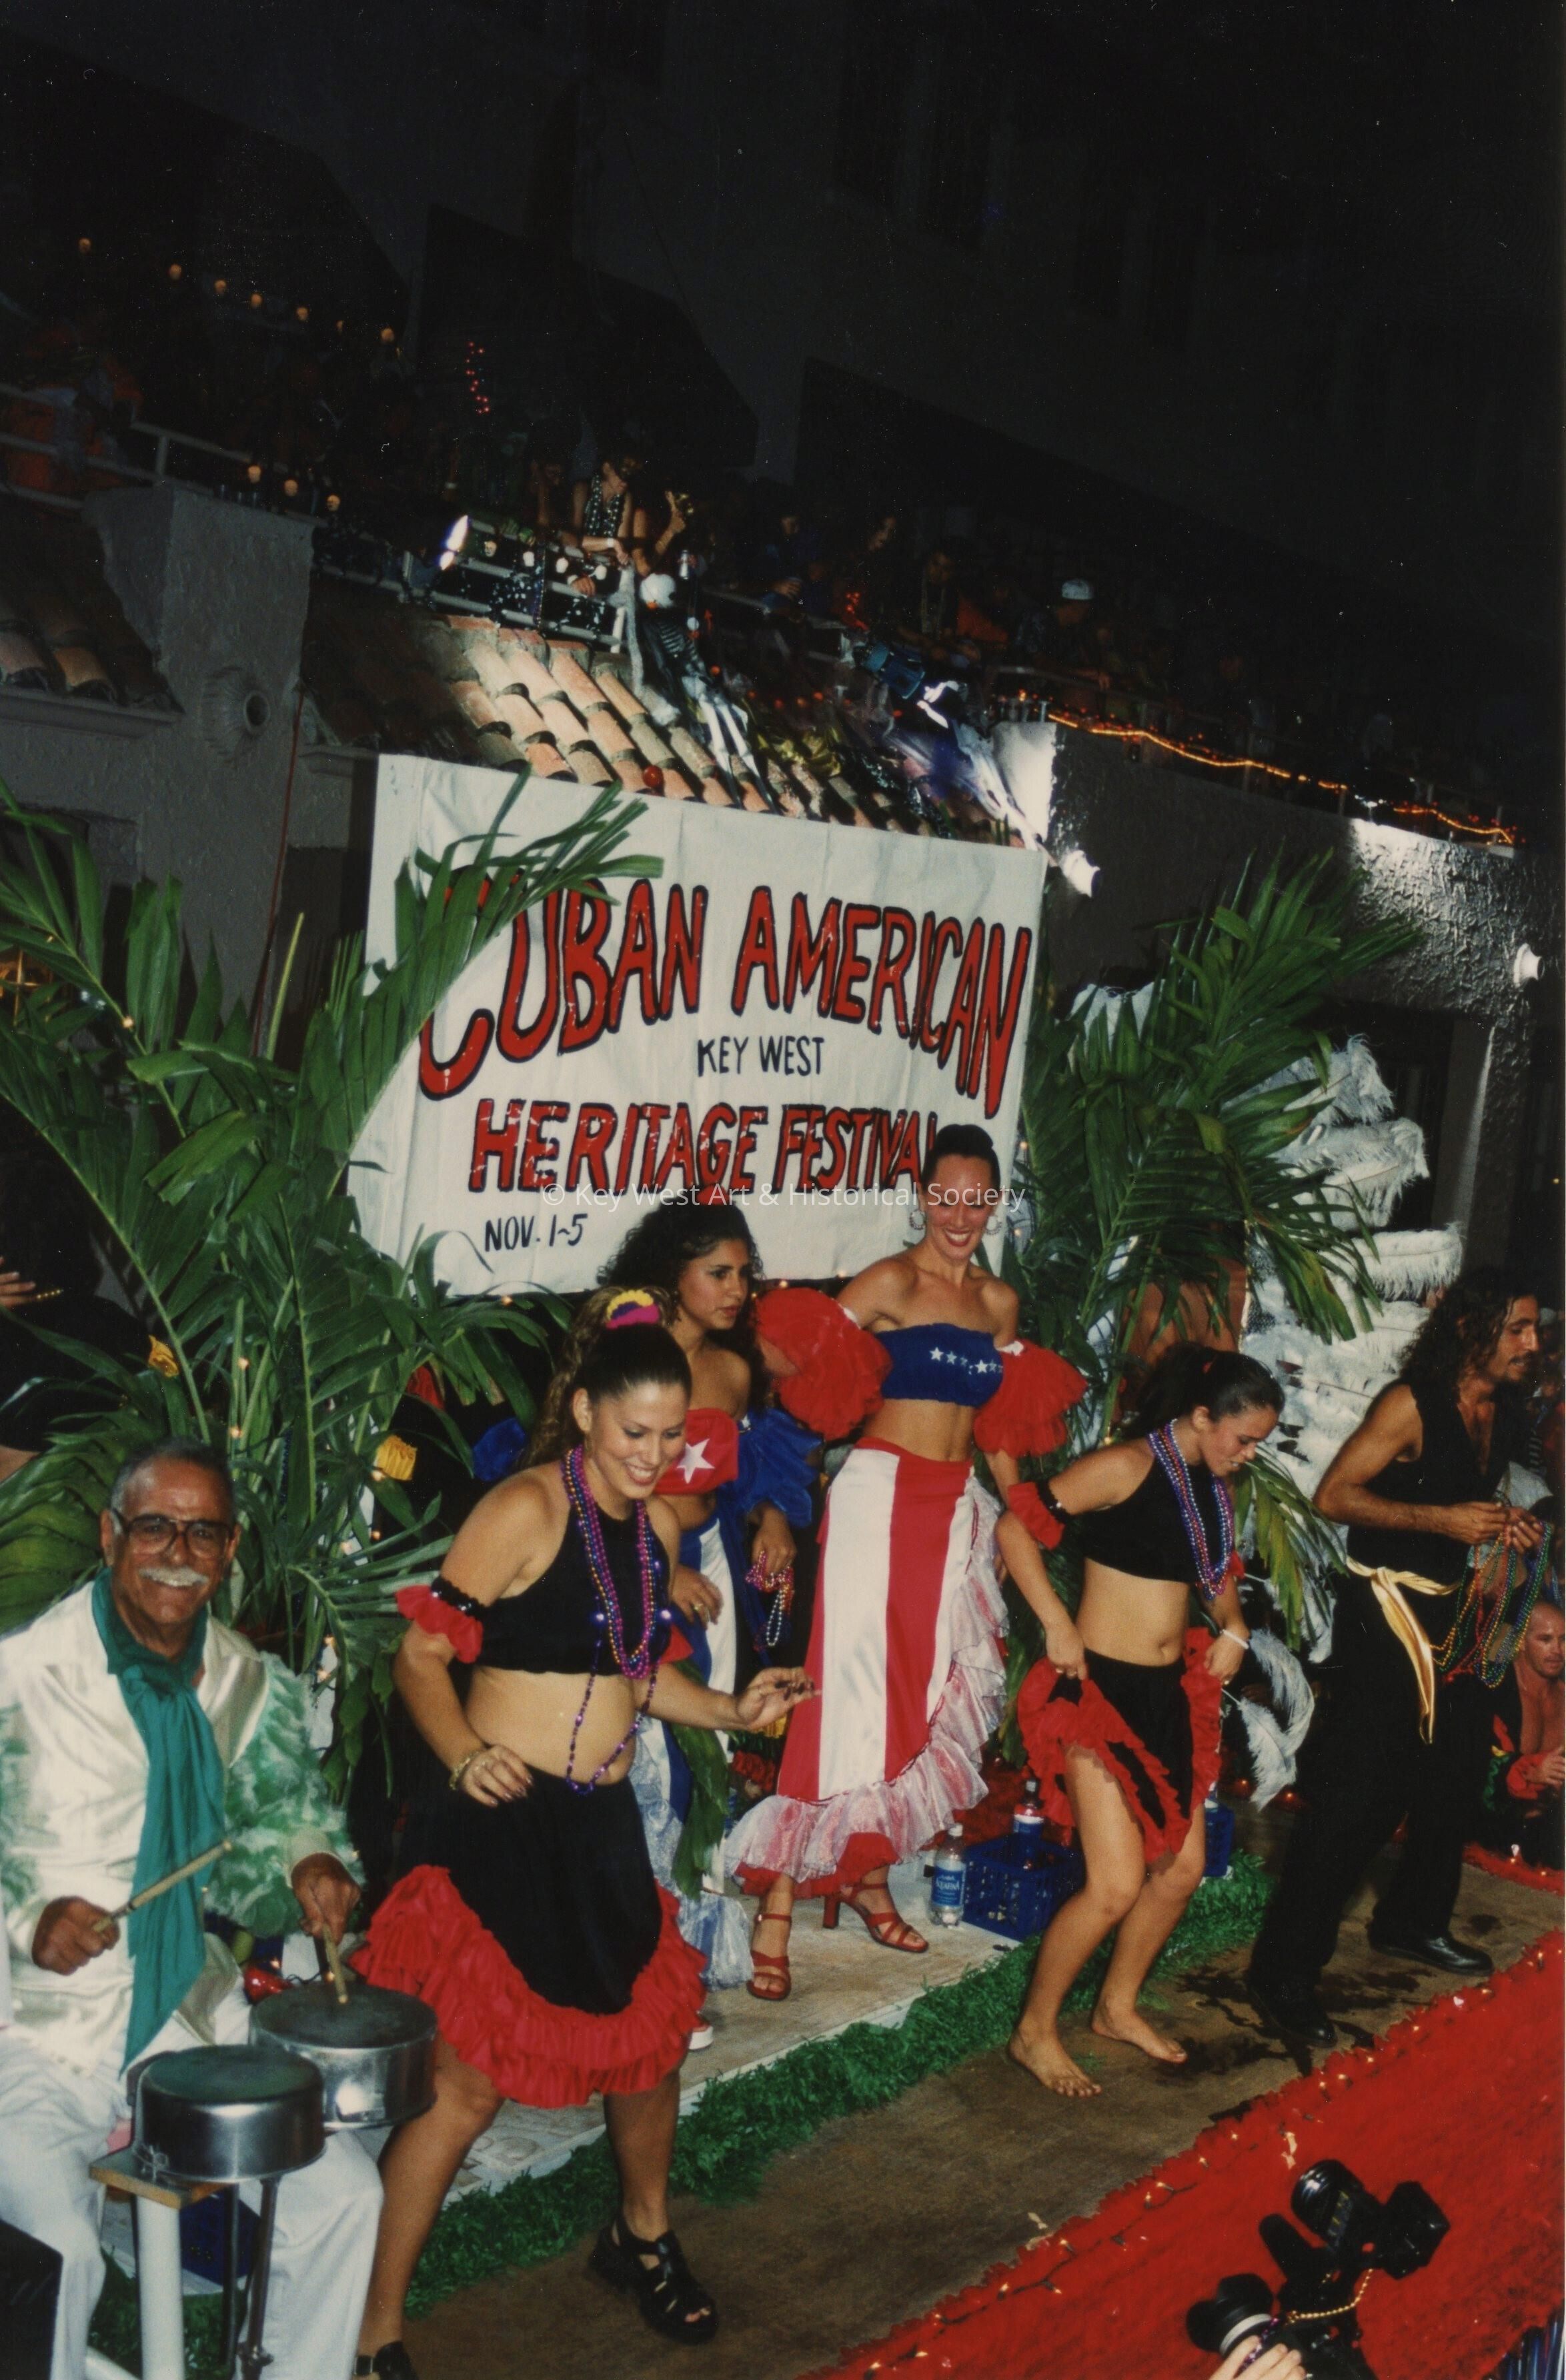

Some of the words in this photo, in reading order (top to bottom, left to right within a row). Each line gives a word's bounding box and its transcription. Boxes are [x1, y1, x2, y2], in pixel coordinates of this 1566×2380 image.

[731, 885, 1032, 1119] AMERICAN
[698, 1037, 749, 1076] KEY
[759, 1036, 824, 1076] WEST
[468, 1098, 768, 1196] HERITAGE
[485, 1216, 540, 1252] NOV.
